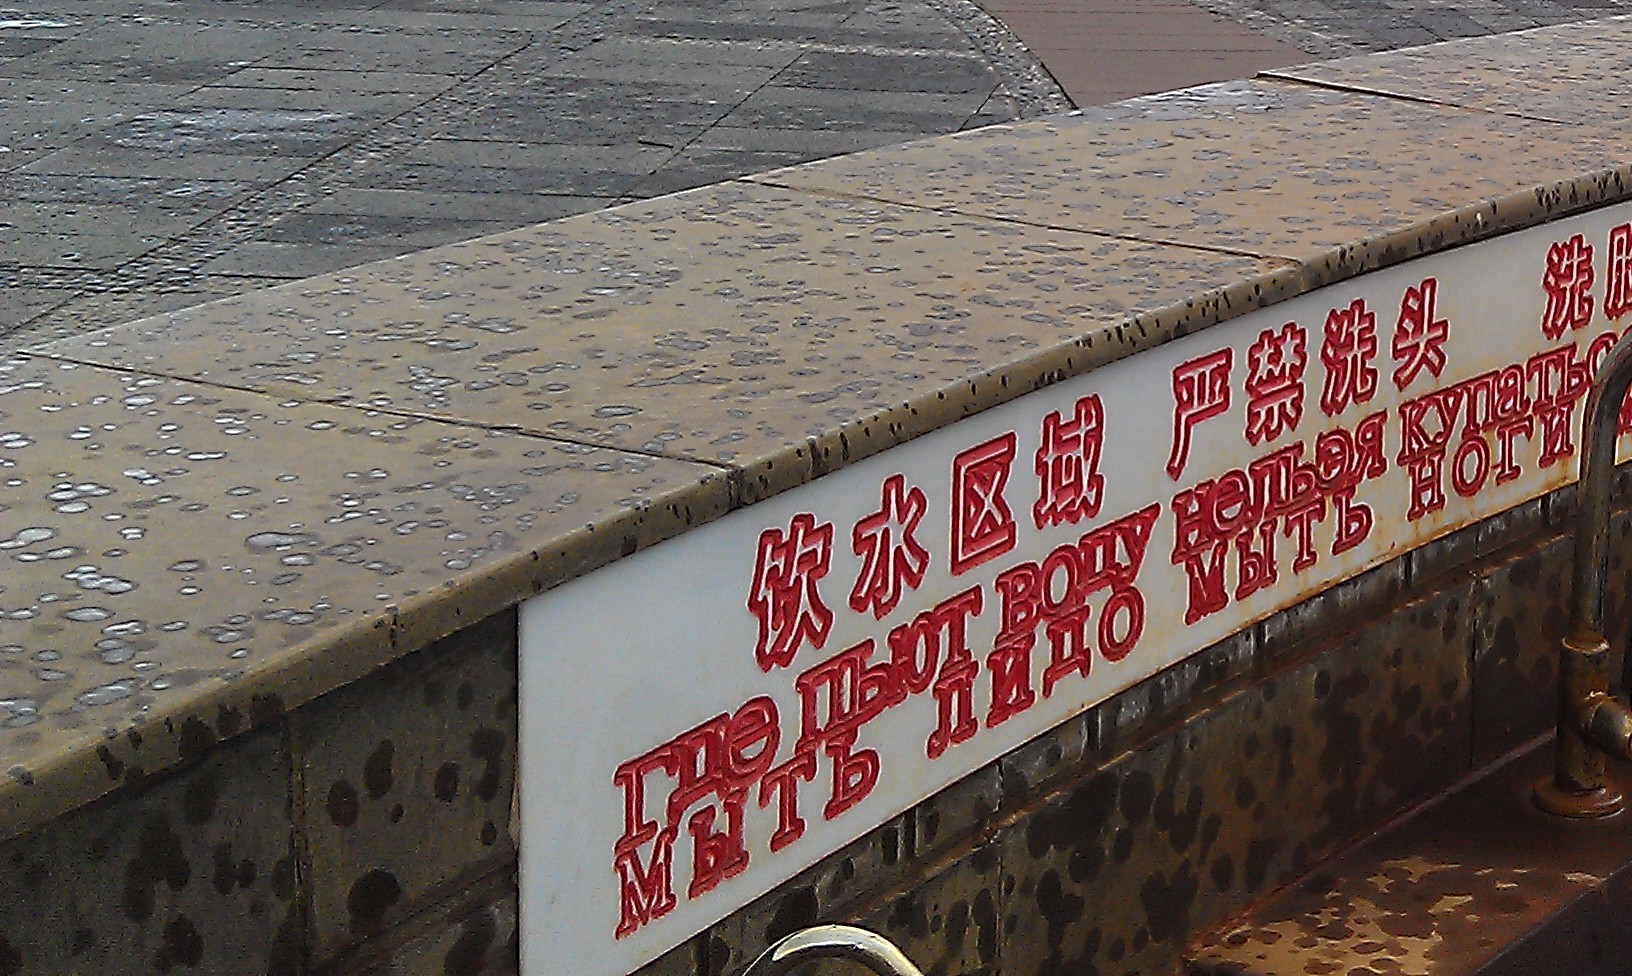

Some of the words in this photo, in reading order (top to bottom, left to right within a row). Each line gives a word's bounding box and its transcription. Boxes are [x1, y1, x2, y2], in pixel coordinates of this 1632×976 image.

[747, 393, 1105, 672] 饮水区域
[1167, 275, 1450, 480] 严禁洗头
